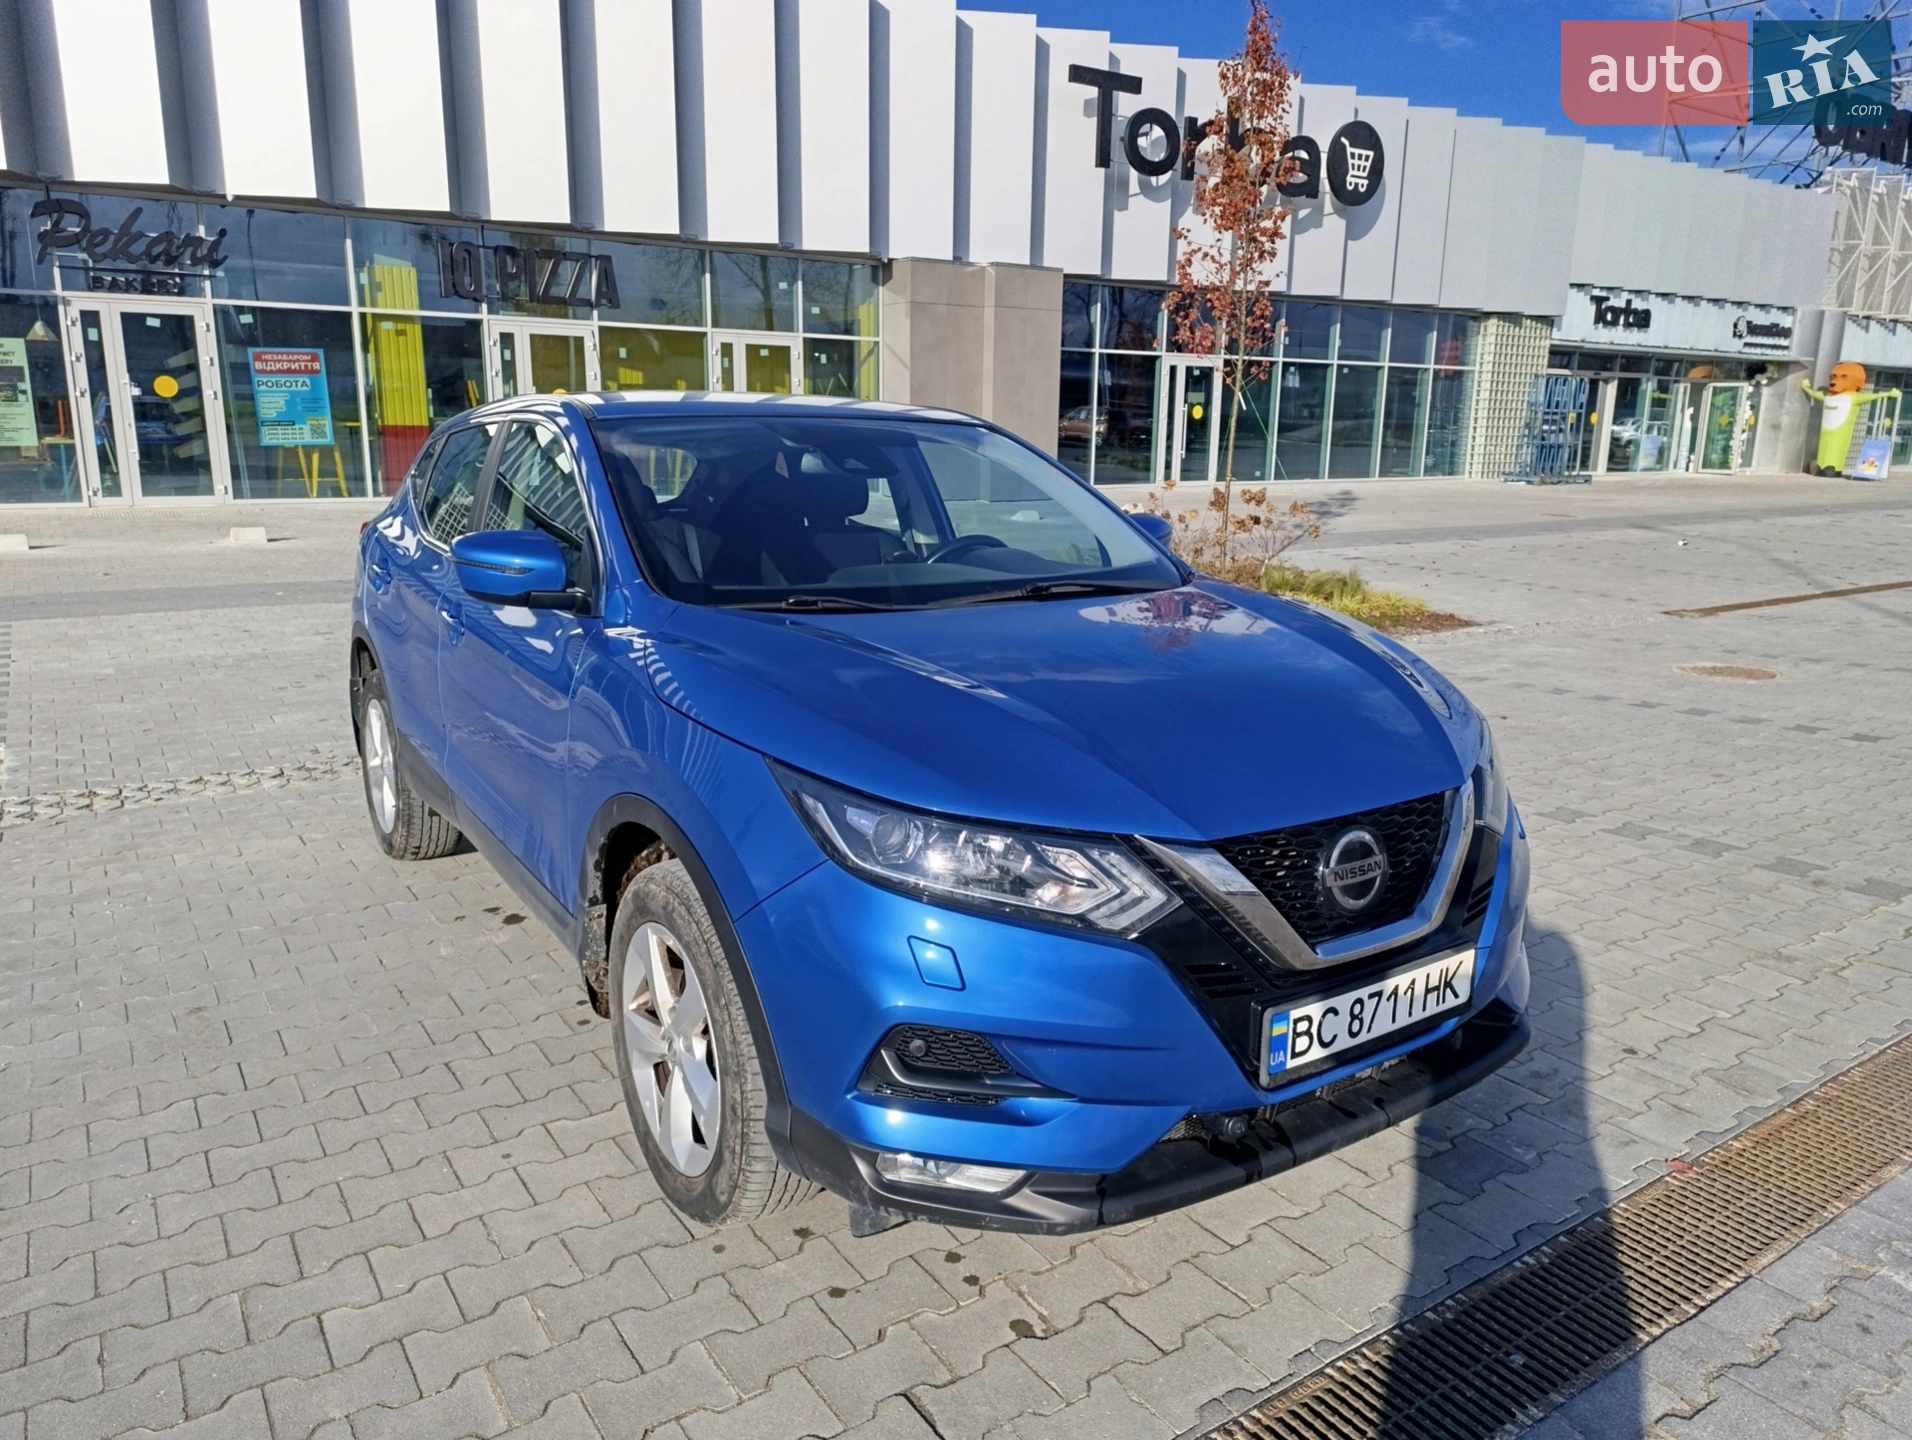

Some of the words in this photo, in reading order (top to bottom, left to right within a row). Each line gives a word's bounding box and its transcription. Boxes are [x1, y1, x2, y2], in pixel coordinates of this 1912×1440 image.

[1069, 63, 1321, 199] Torba
[30, 198, 229, 269] Pekari
[92, 276, 181, 295] BAKERY
[436, 240, 485, 303] IQ
[494, 244, 621, 309] PIZZA
[1589, 295, 1651, 329] Torba
[254, 361, 320, 371] ВІДКРИТТЯ
[256, 379, 310, 389] РОБОТА
[1333, 859, 1381, 883] NISSAN
[1290, 1007, 1339, 1060] BC
[1347, 976, 1416, 1039] 8711
[1421, 961, 1464, 1012] HK
[1269, 1053, 1286, 1066] UA
